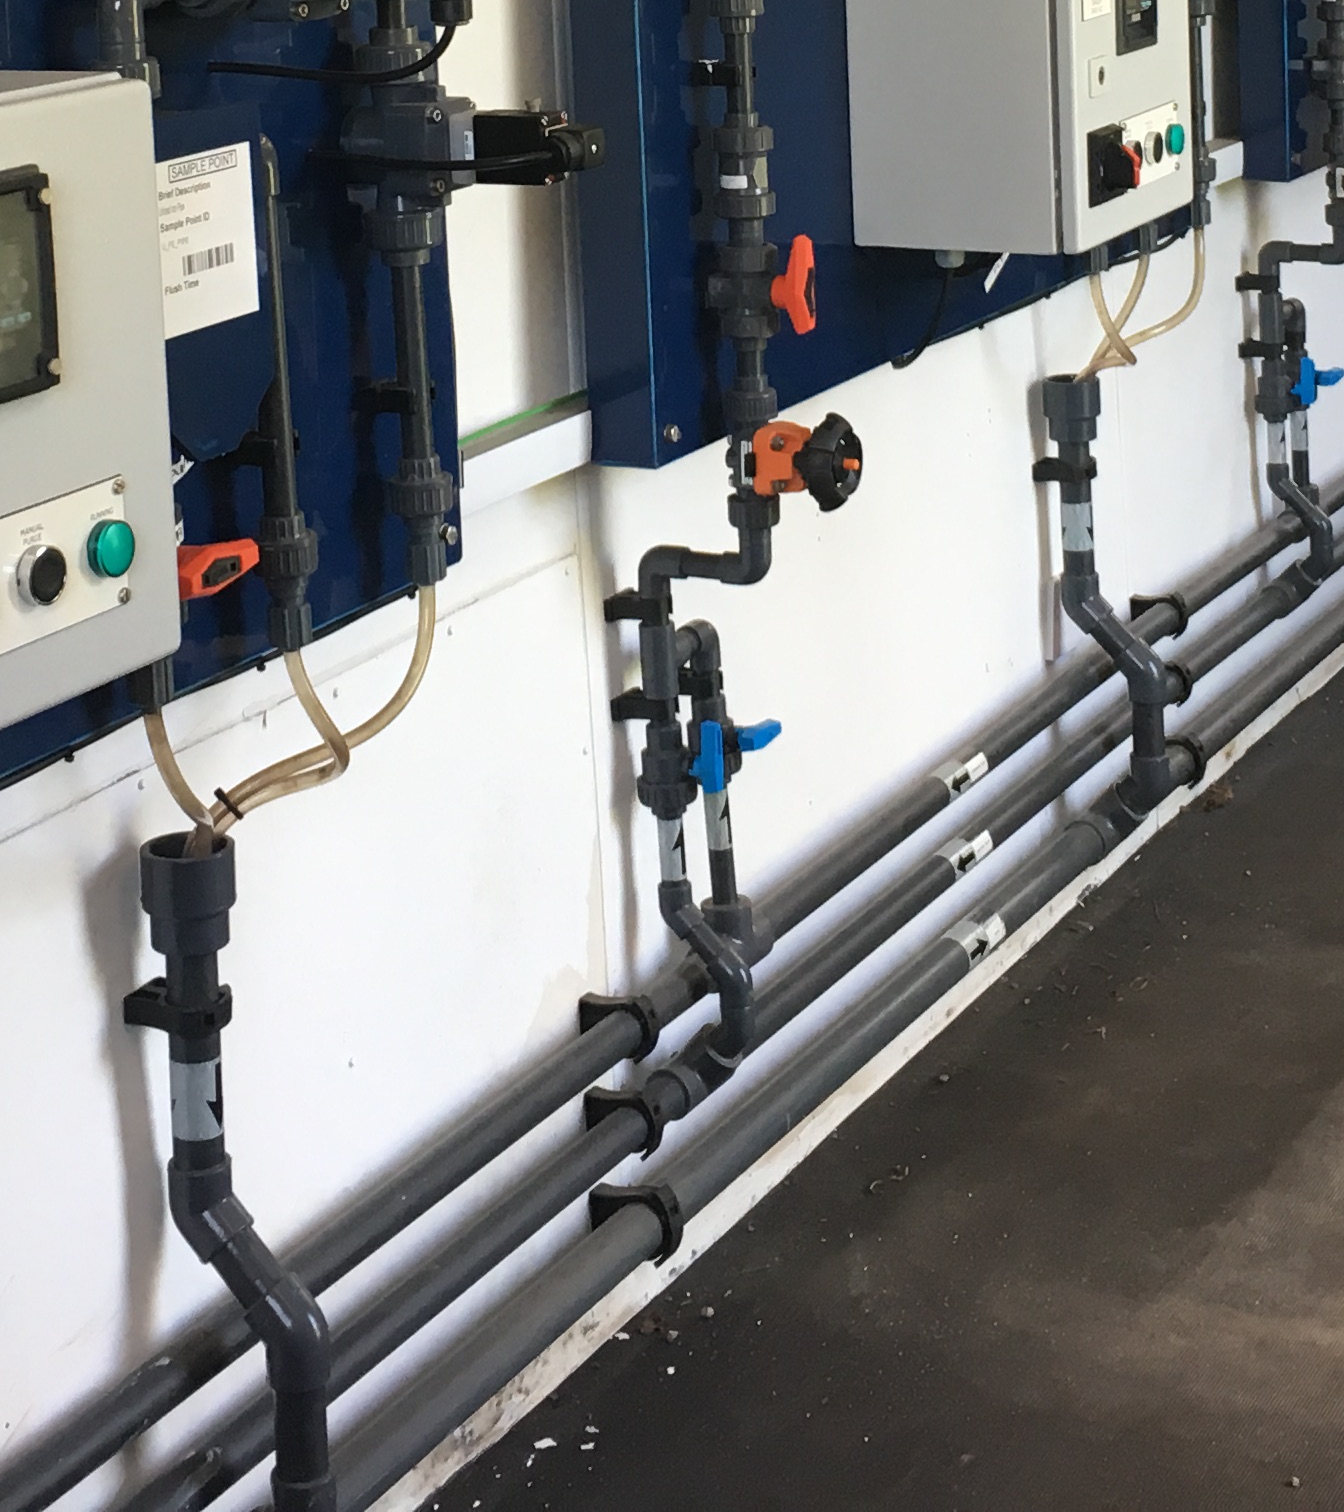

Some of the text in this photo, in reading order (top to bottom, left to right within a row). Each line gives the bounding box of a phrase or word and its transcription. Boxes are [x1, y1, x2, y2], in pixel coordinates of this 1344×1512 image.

[171, 152, 234, 179] SAMPLE POINT
[158, 182, 211, 201] Brief Description
[160, 211, 210, 233] Sample Point ID
[164, 280, 199, 295] Flush Time
[20, 523, 44, 536] MANUAL
